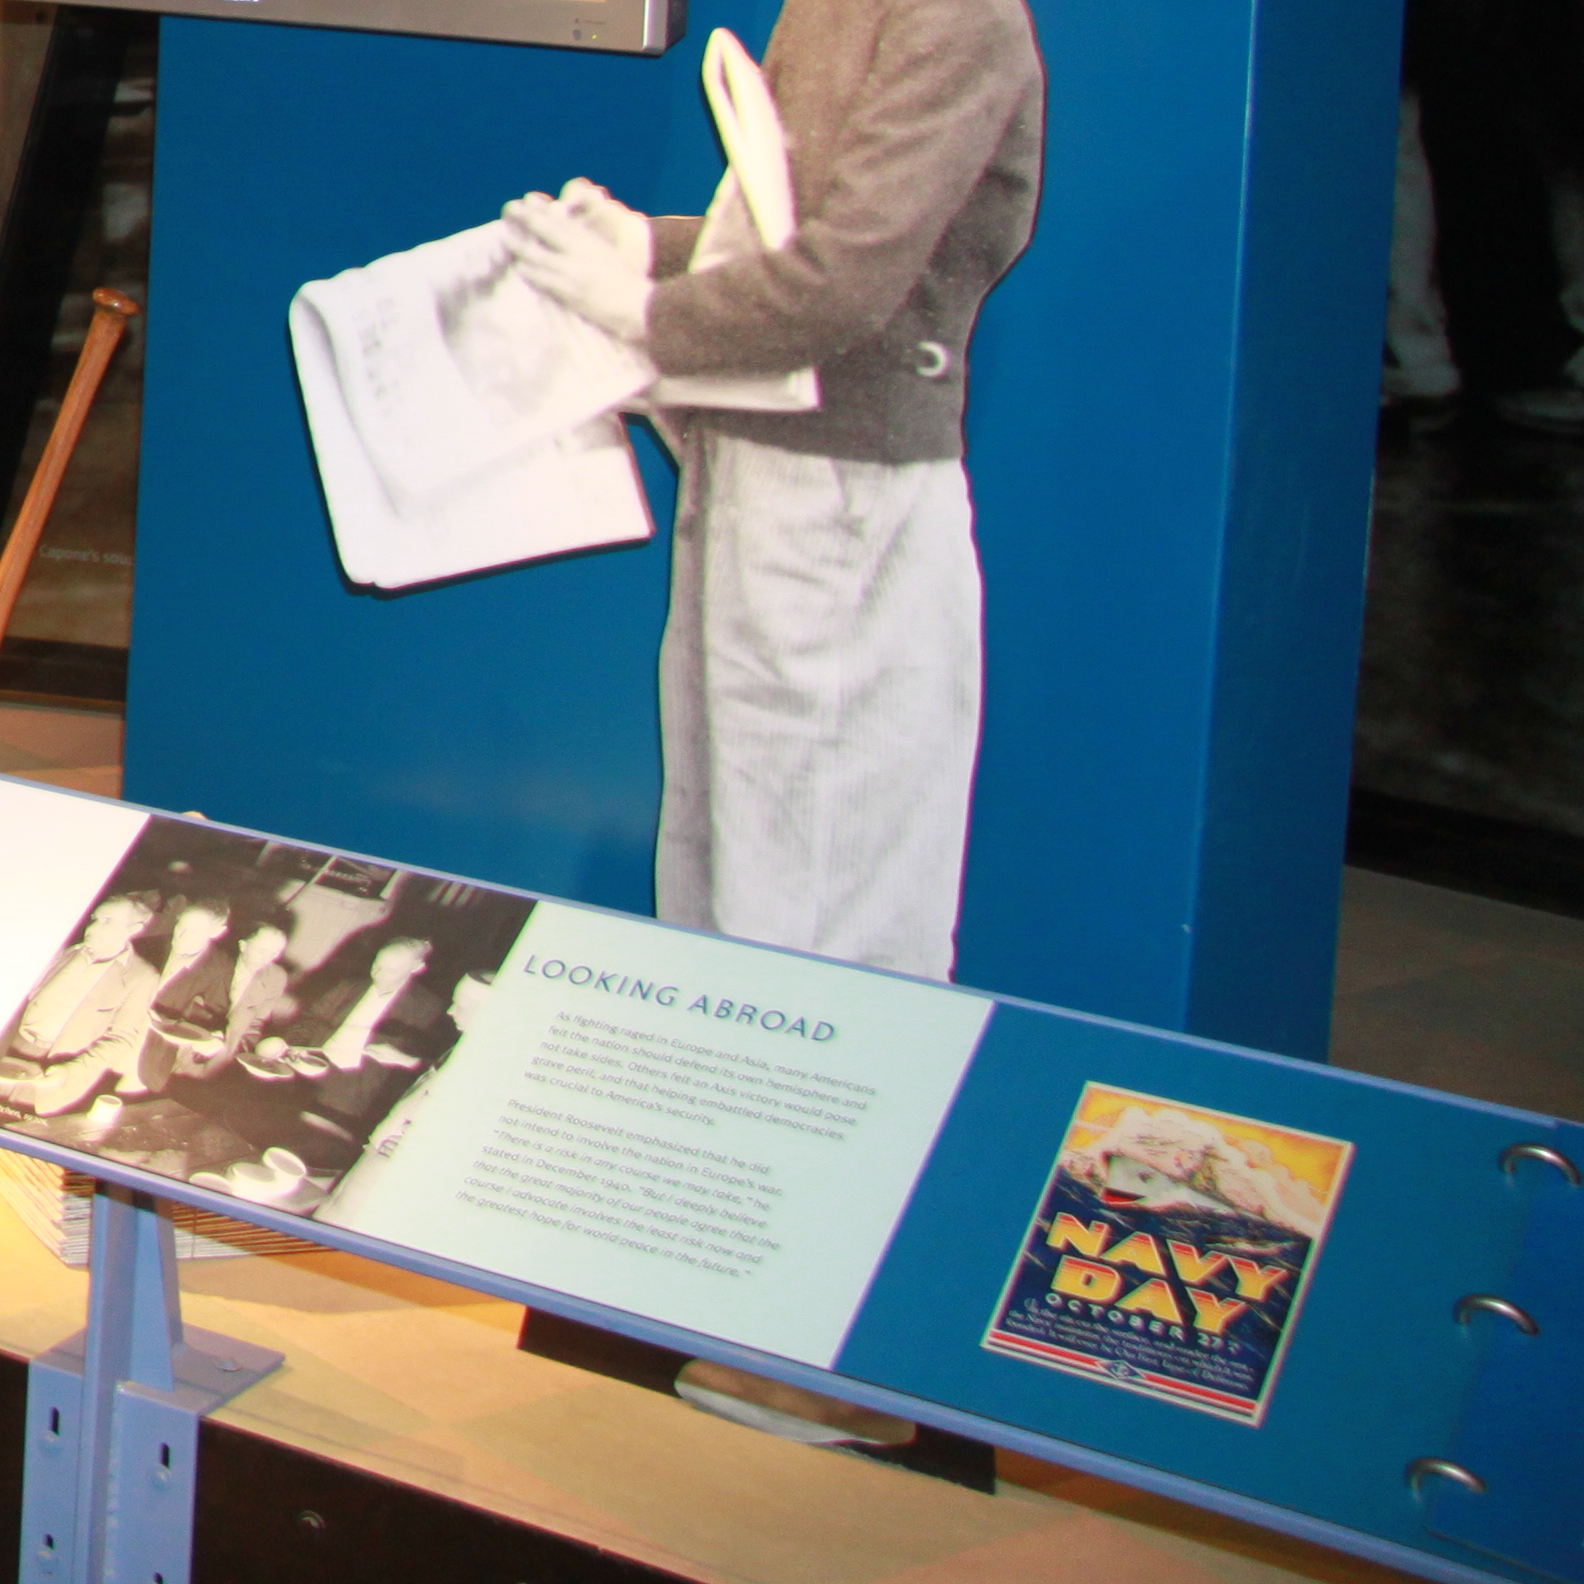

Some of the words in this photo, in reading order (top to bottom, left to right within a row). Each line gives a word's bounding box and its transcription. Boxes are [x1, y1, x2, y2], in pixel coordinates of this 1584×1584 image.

[524, 955, 679, 1007] LOOKING
[688, 994, 836, 1042] ABROAD
[573, 1016, 620, 1037] fighting
[621, 1029, 654, 1044] raged
[670, 1038, 713, 1059] Europe
[714, 1050, 738, 1062] and
[774, 1065, 809, 1081] many
[809, 1073, 878, 1098] Americans
[1045, 1212, 1290, 1302] NAVY
[1050, 1255, 1248, 1335] DAY
[1044, 1292, 1187, 1342] OCTOBER
